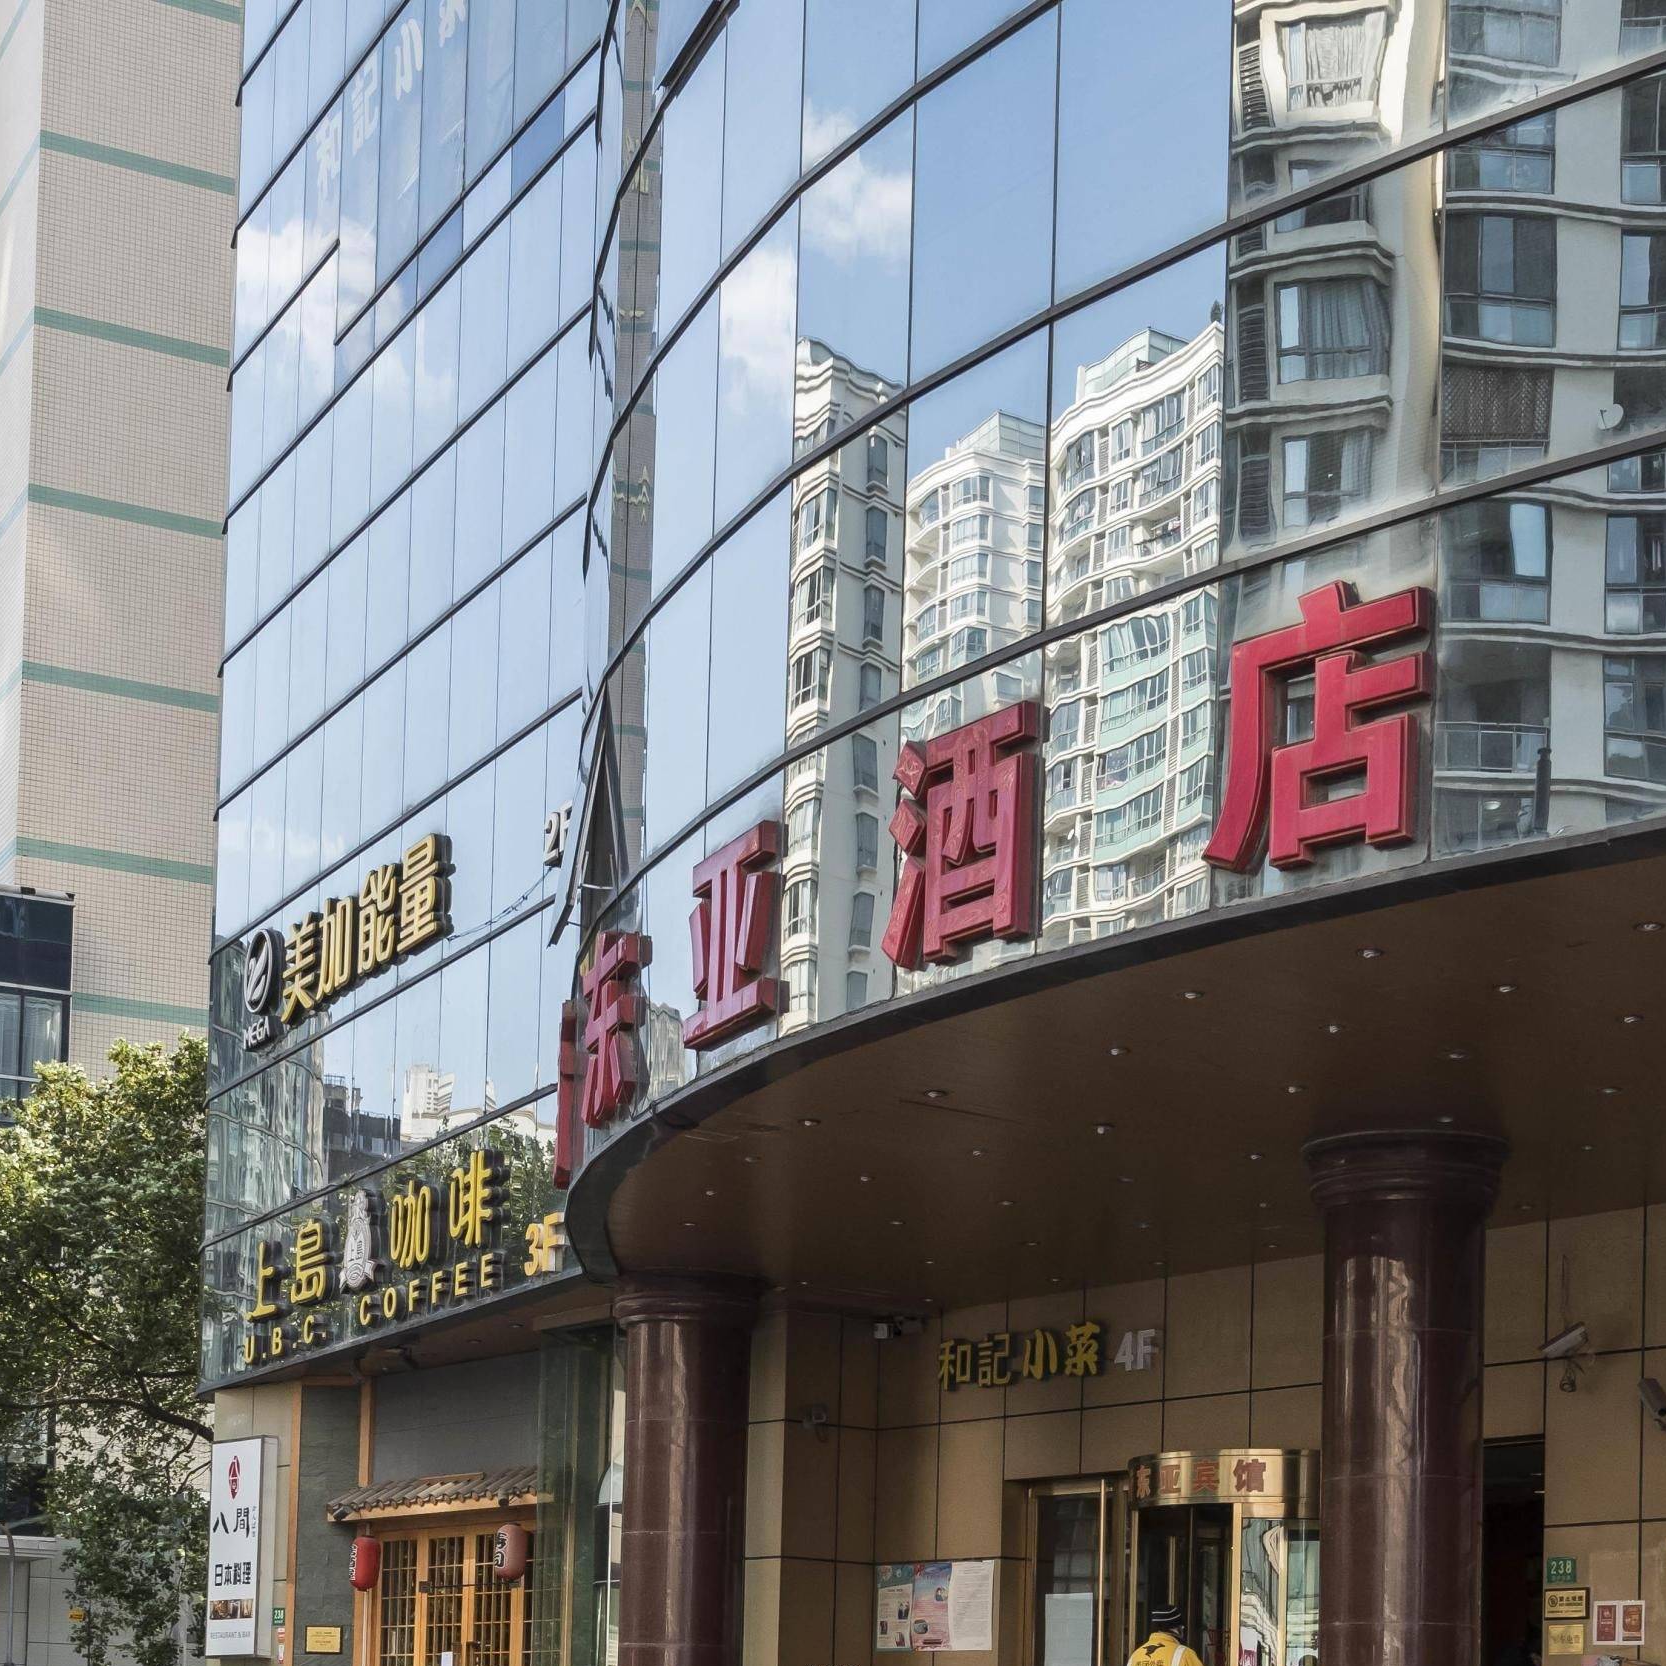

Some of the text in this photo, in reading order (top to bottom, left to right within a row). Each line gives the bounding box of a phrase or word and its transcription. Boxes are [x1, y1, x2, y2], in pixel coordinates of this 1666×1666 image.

[281, 833, 441, 1024] 美加能量
[244, 1016, 271, 1049] MEGA
[524, 1211, 567, 1277] 3F
[359, 1252, 495, 1327] COFFEE
[937, 1321, 1157, 1392] 和記小菜 4F
[214, 1561, 252, 1587] 日本料理
[1550, 1560, 1572, 1574] 238
[273, 1609, 284, 1620] 238
[209, 1631, 238, 1640] RESTAURANT
[242, 1630, 252, 1638] BAR
